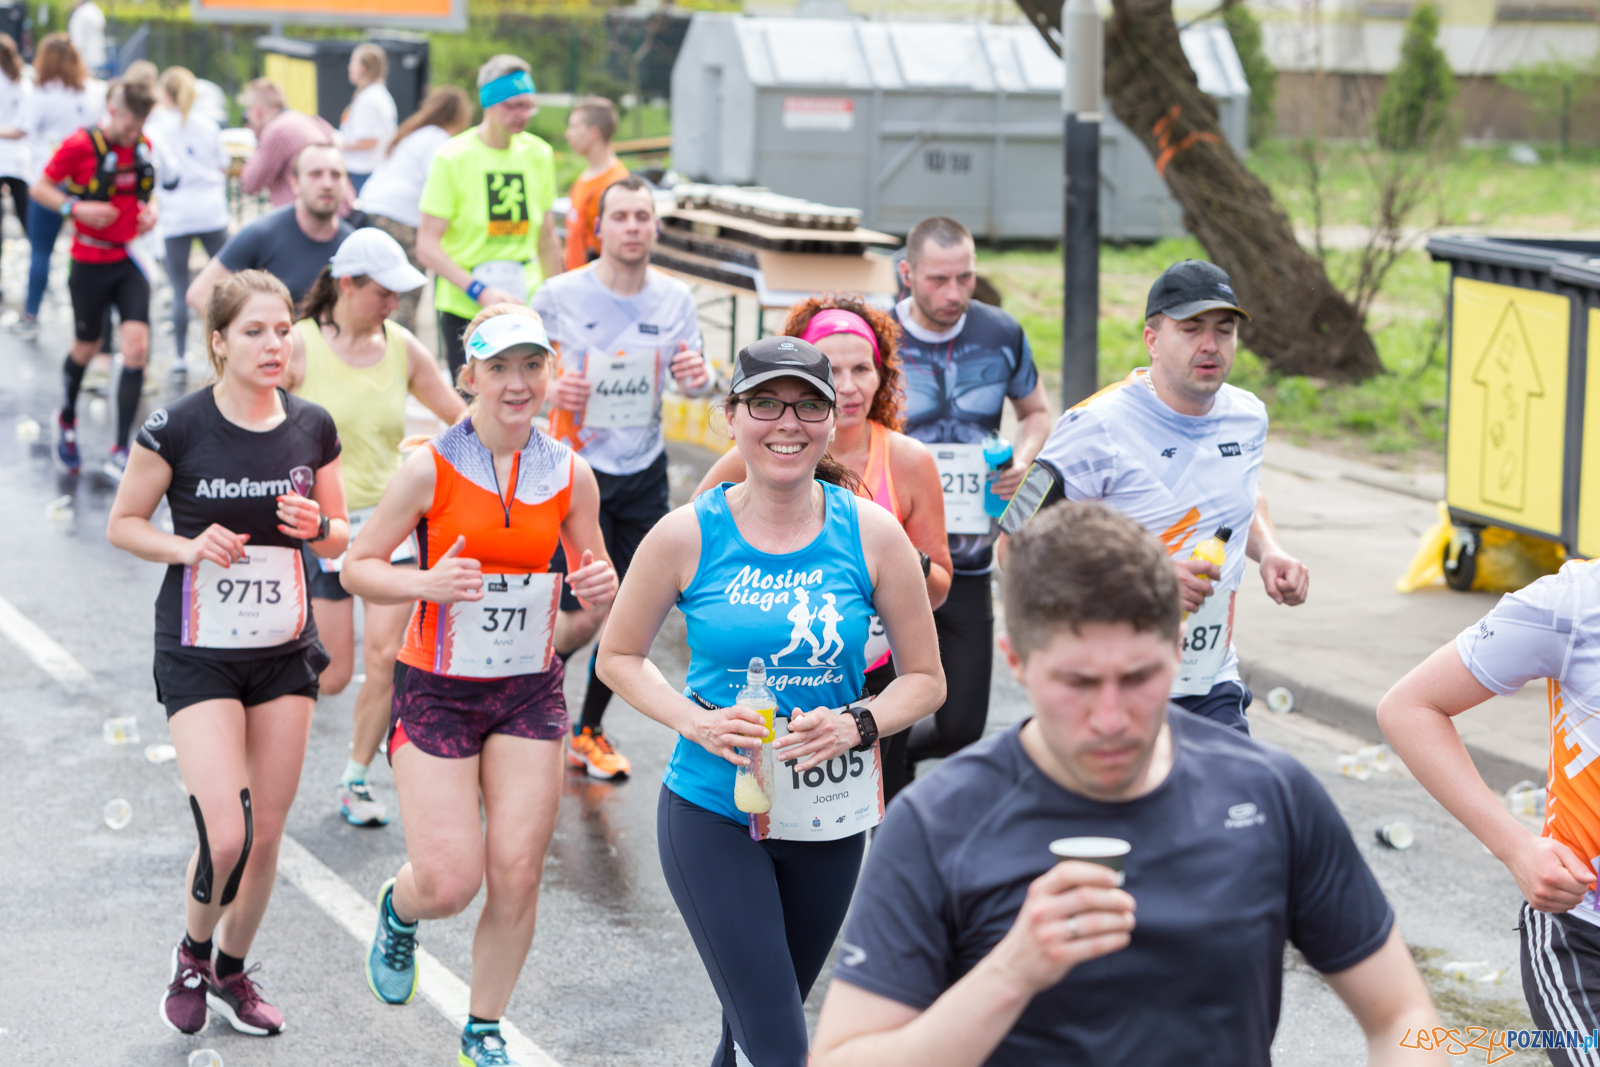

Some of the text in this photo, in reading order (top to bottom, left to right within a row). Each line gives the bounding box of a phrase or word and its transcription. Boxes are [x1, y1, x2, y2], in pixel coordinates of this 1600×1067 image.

[596, 375, 649, 396] 4446
[195, 477, 292, 499] Aflofarm
[942, 472, 980, 493] 213
[724, 565, 823, 594] Mosina
[217, 578, 281, 604] 9713
[729, 583, 789, 612] biega
[238, 609, 260, 618] Anna
[482, 607, 527, 632] 371
[813, 790, 849, 804] Joanna
